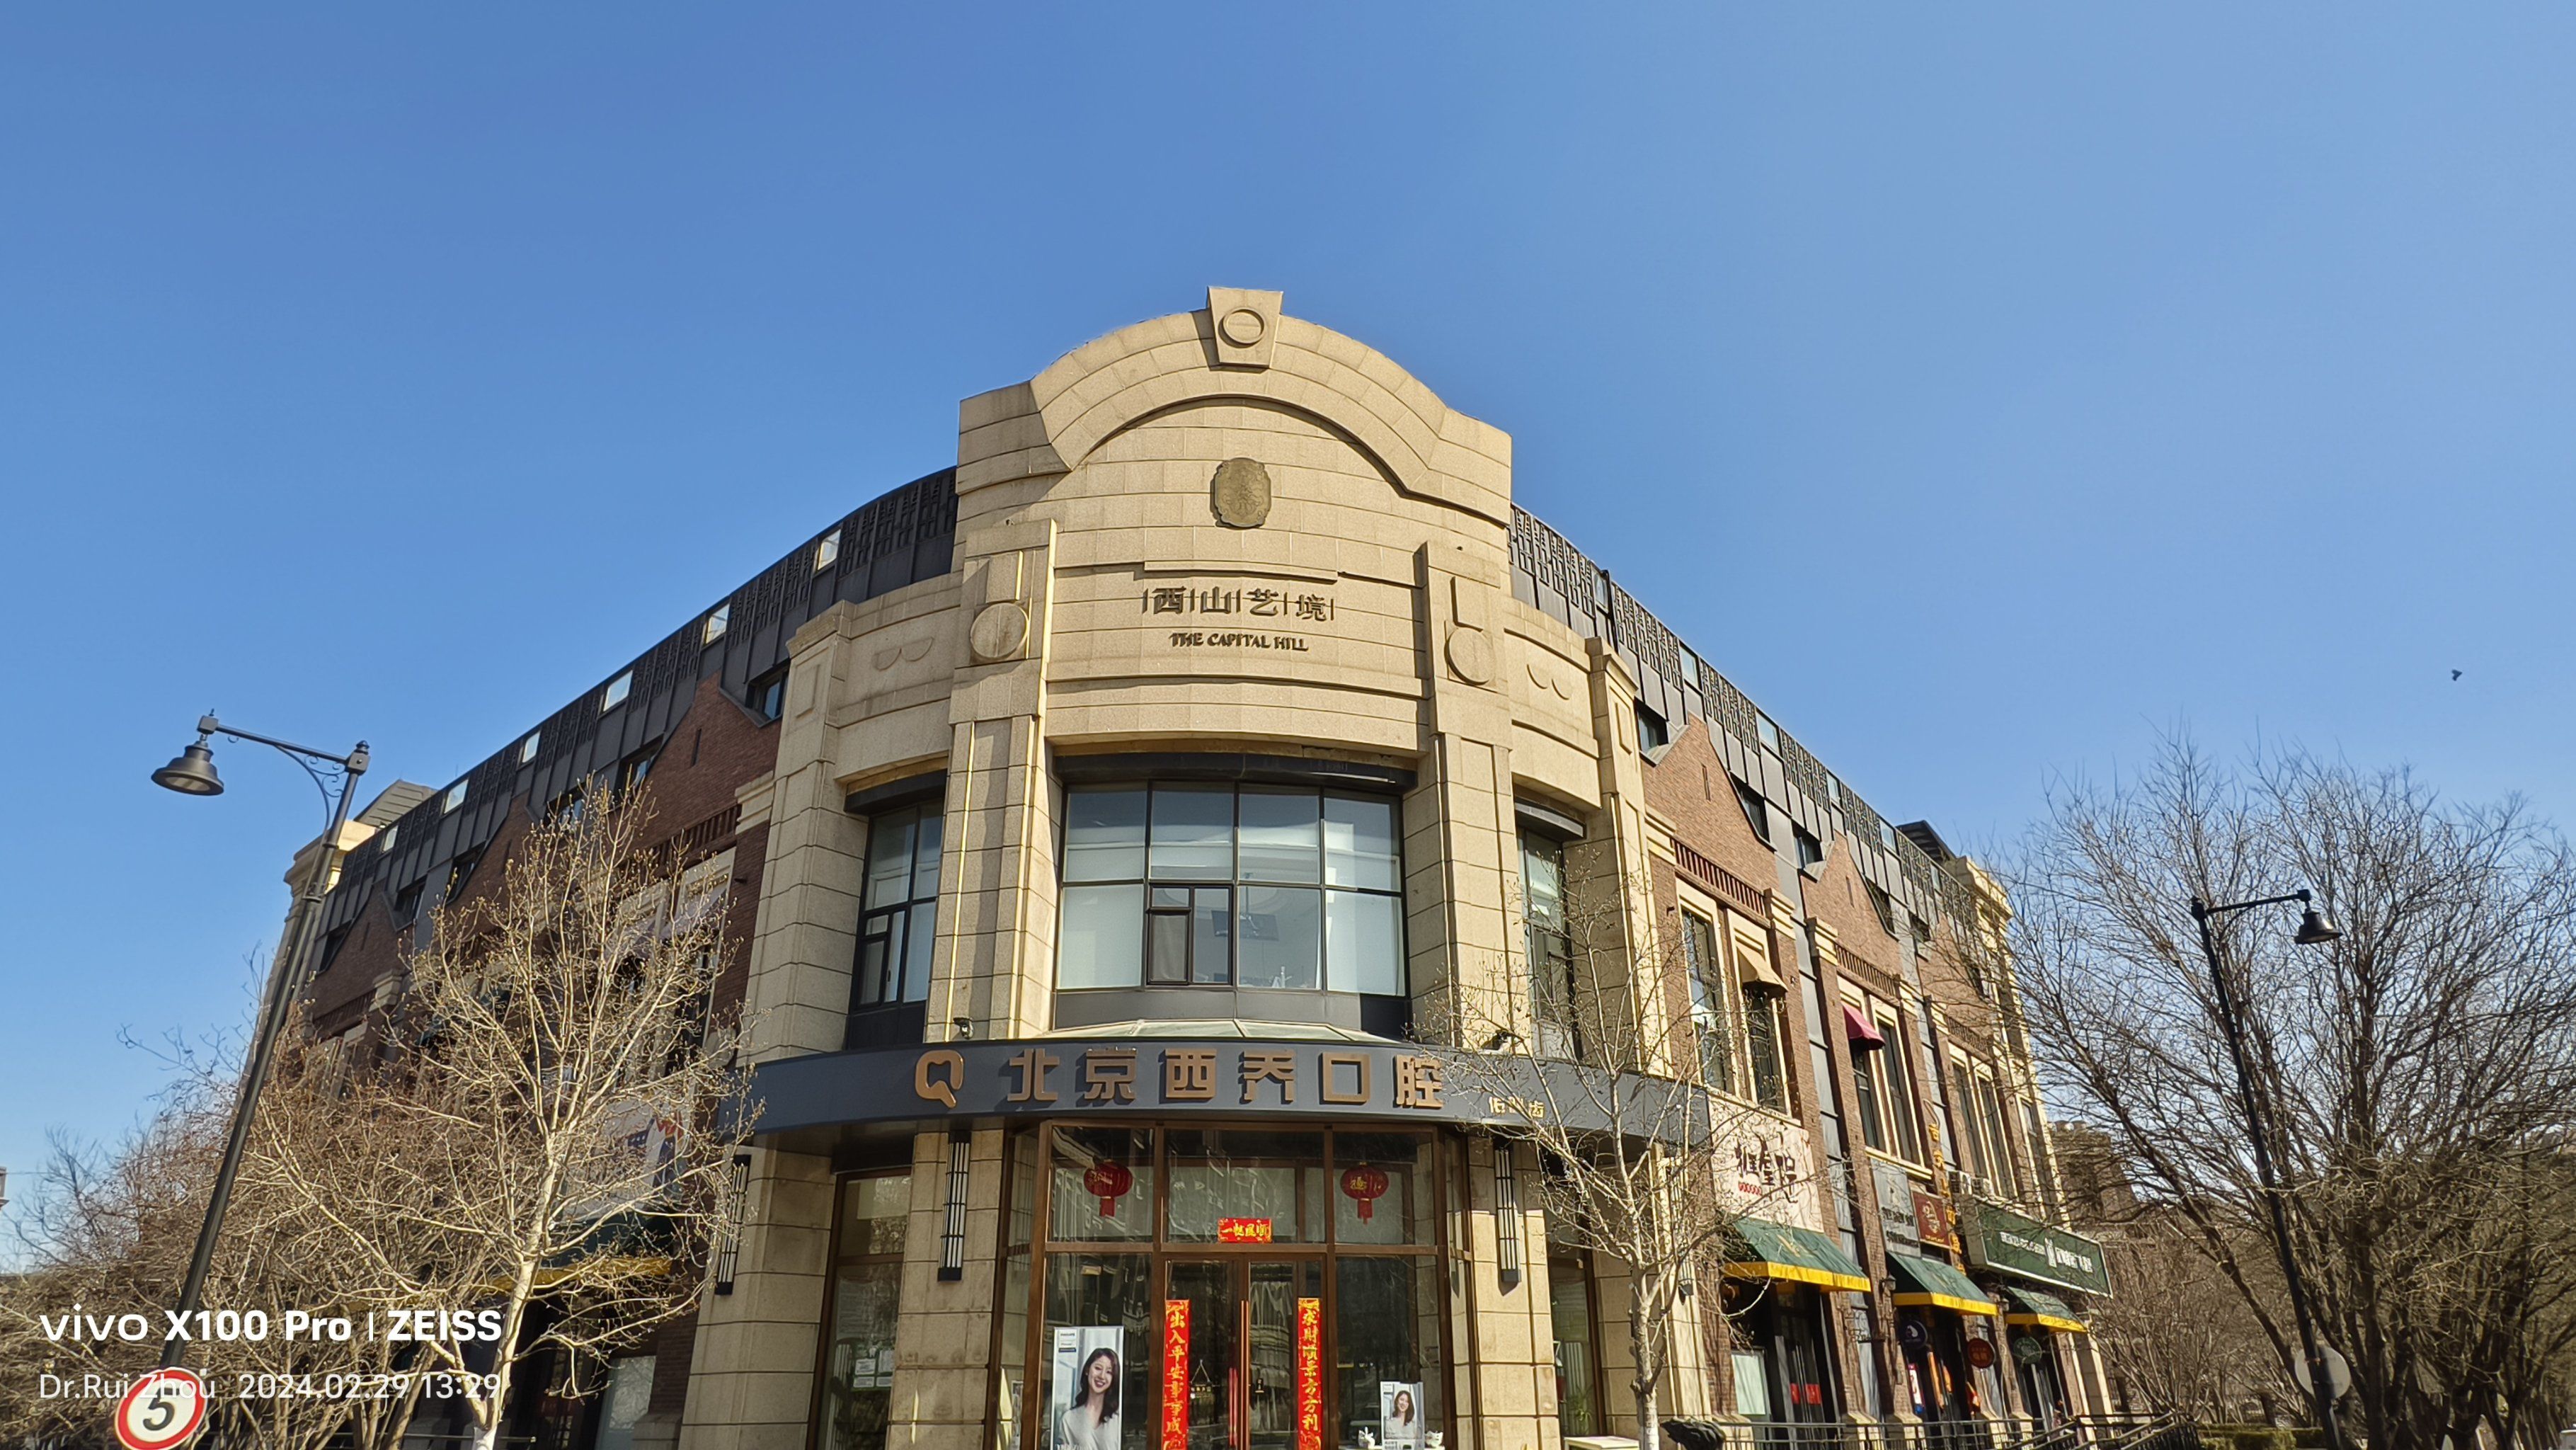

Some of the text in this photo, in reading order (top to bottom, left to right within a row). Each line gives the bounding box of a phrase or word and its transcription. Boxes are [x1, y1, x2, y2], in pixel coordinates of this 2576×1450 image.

[1169, 632, 1309, 651] THE CAPITAL HILL
[143, 1386, 175, 1431] 5
